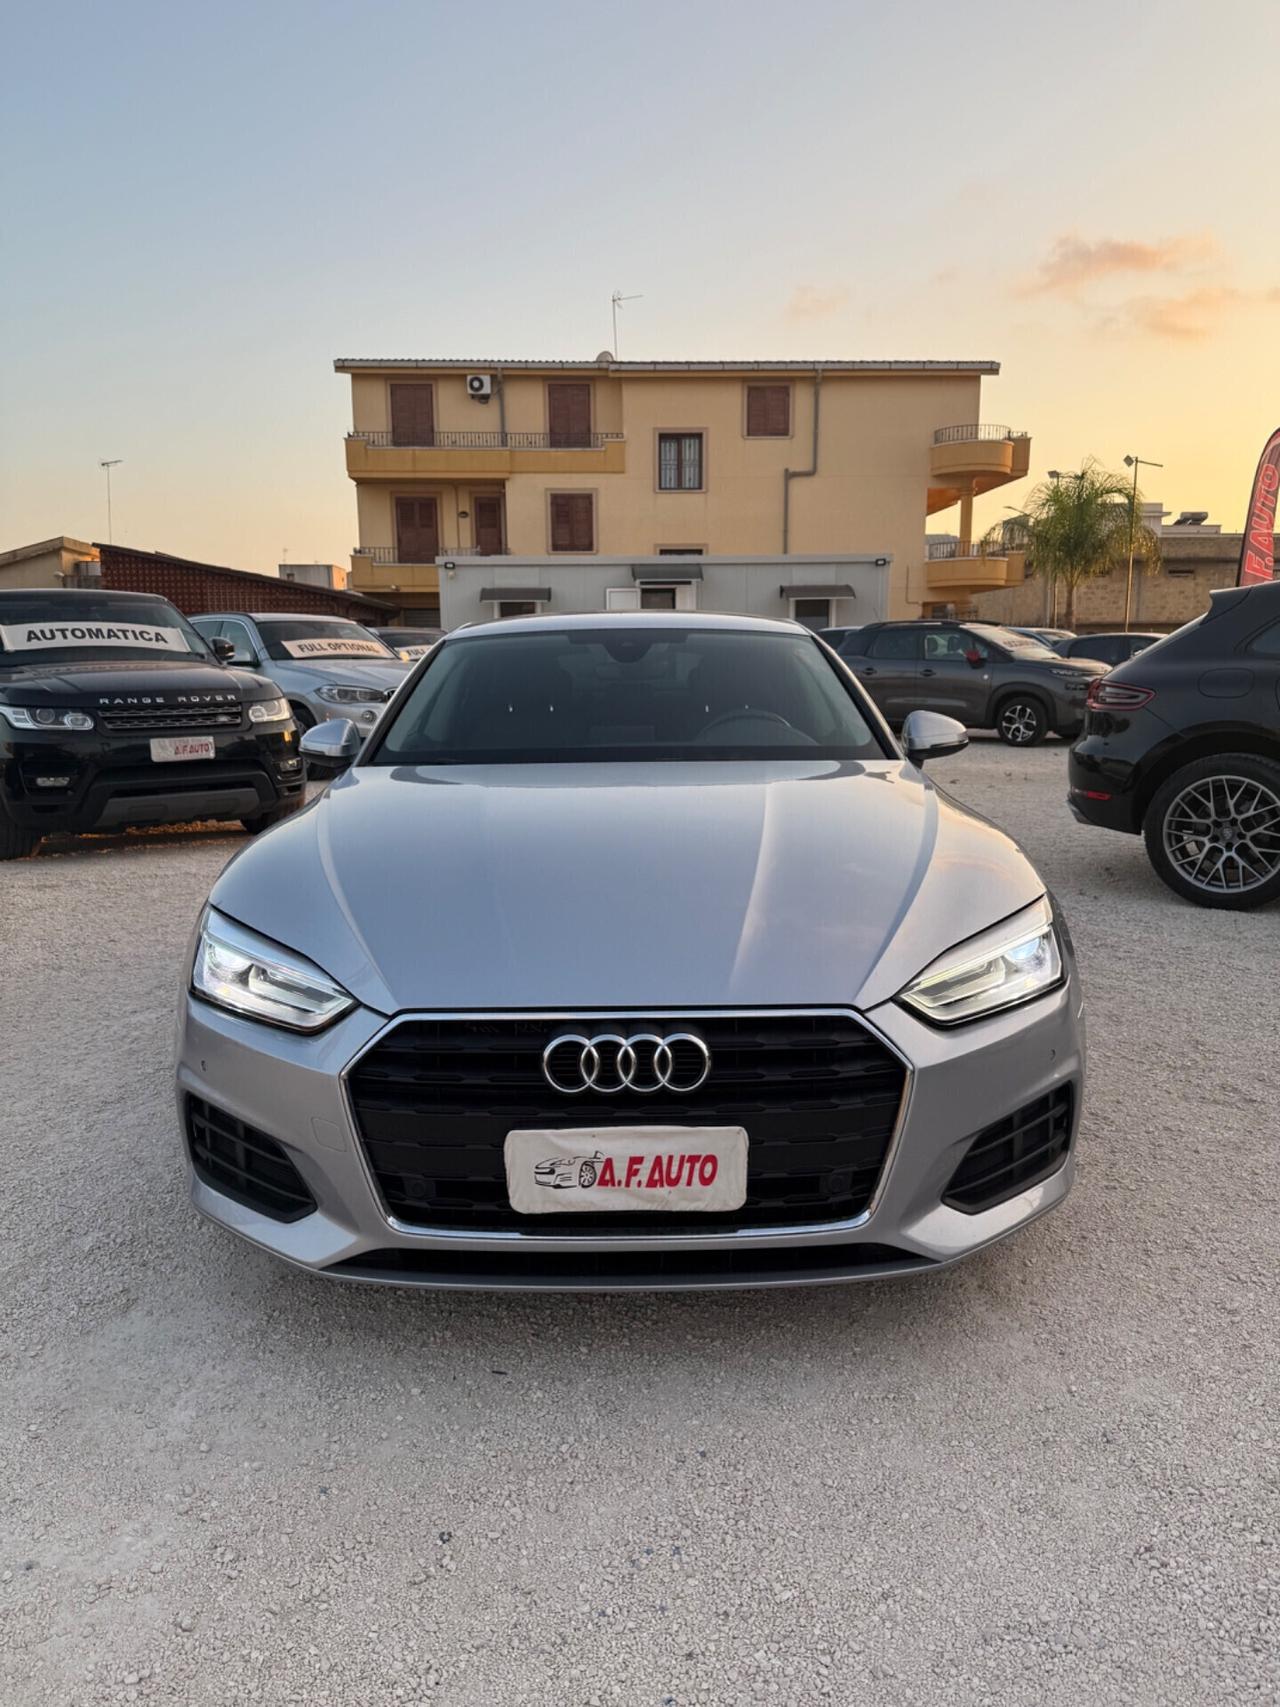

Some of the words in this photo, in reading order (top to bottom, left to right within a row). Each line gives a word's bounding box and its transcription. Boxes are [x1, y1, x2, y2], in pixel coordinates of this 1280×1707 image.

[26, 627, 168, 644] AUTOMATICA
[297, 643, 328, 653] FULL
[327, 642, 381, 654] OPTIONAL
[99, 697, 165, 705] RANGE
[177, 694, 236, 703] ROVER
